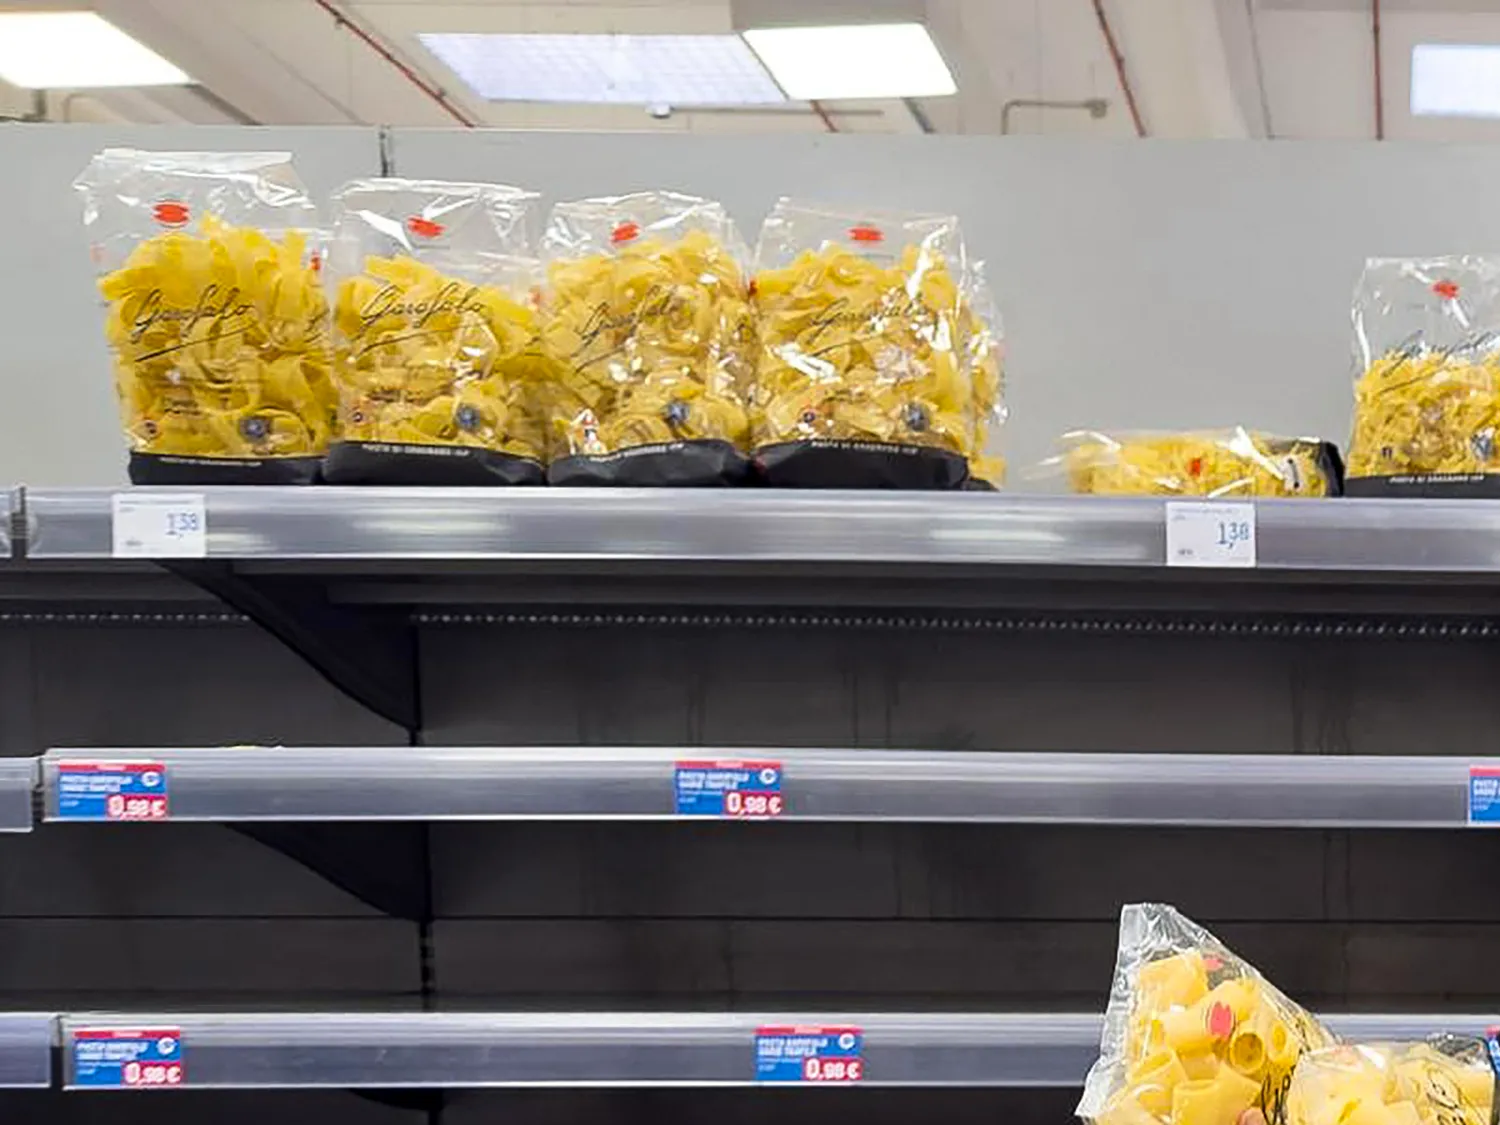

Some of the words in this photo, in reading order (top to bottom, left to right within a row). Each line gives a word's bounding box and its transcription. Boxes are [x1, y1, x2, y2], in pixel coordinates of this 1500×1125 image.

[130, 283, 256, 340] Garofalo
[354, 281, 487, 342] Garofalo
[1215, 521, 1249, 550] 1,38
